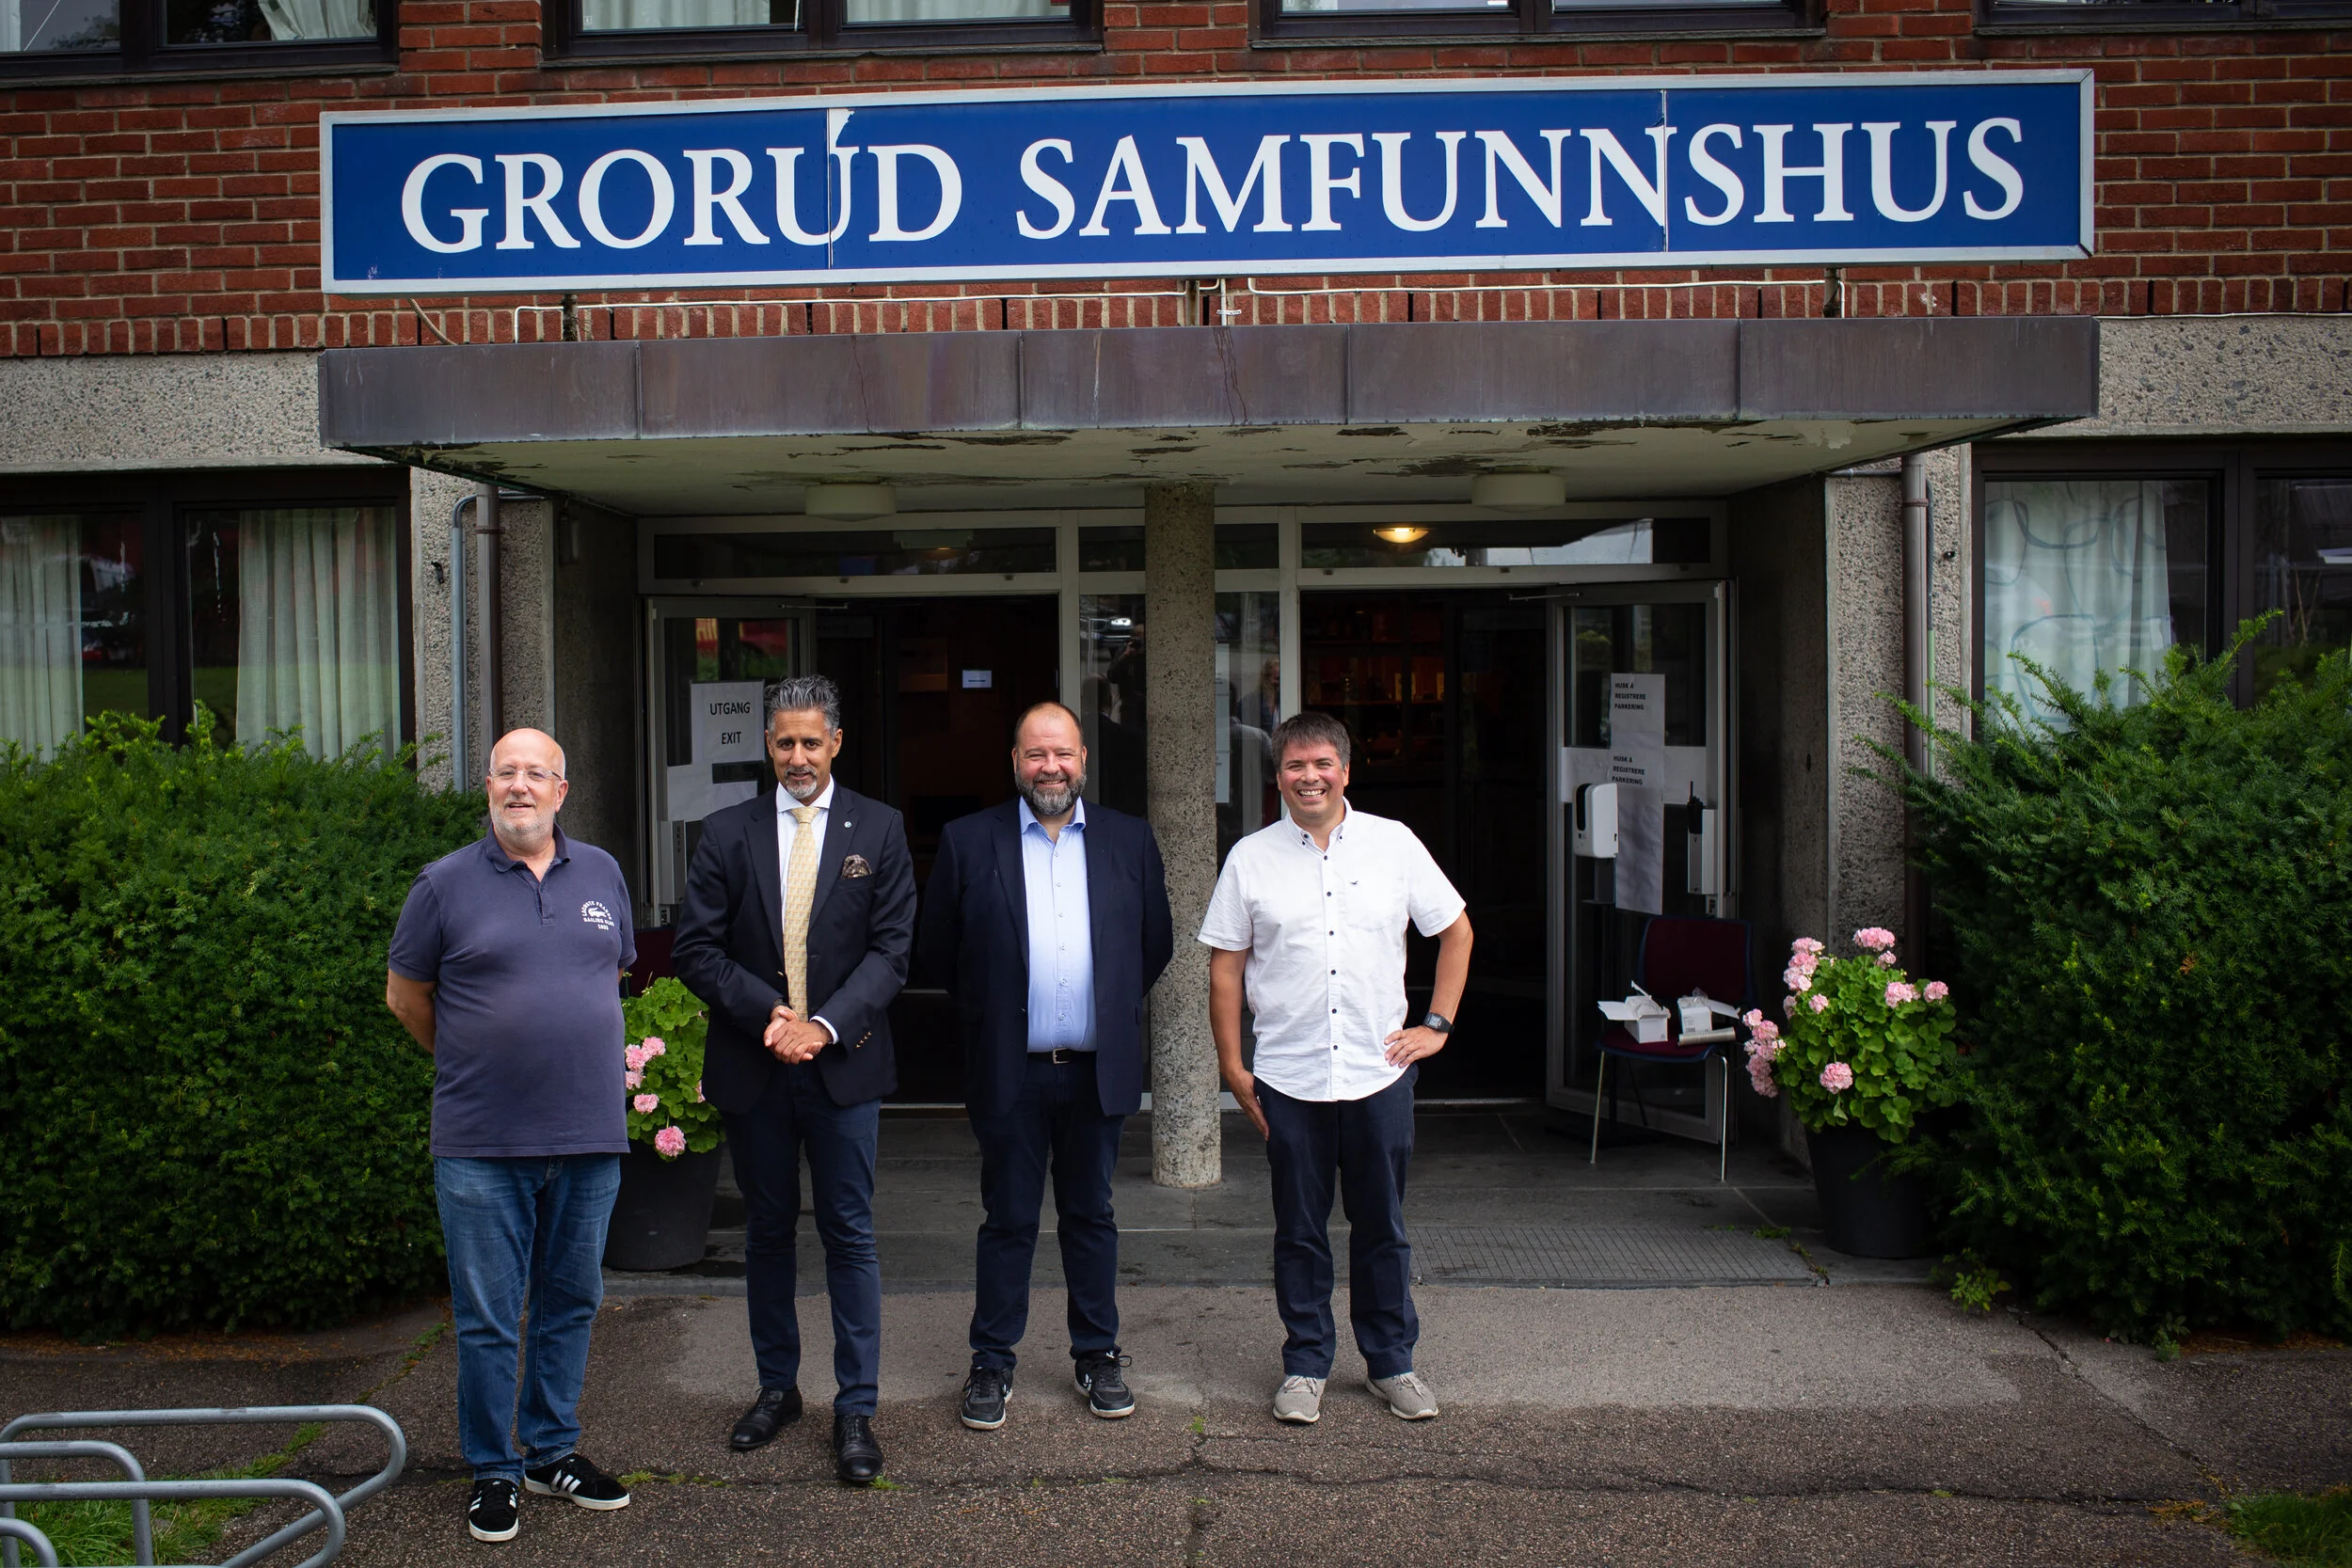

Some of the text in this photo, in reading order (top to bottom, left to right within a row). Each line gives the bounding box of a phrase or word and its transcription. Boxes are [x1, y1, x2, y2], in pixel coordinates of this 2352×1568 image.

[400, 117, 2025, 255] GRORUD SAMFUNNSHUS
[709, 702, 752, 716] UTGANG
[721, 731, 742, 745] EXIT
[1613, 766, 1645, 775] REGISTRERE
[1612, 776, 1643, 785] PARKERING
